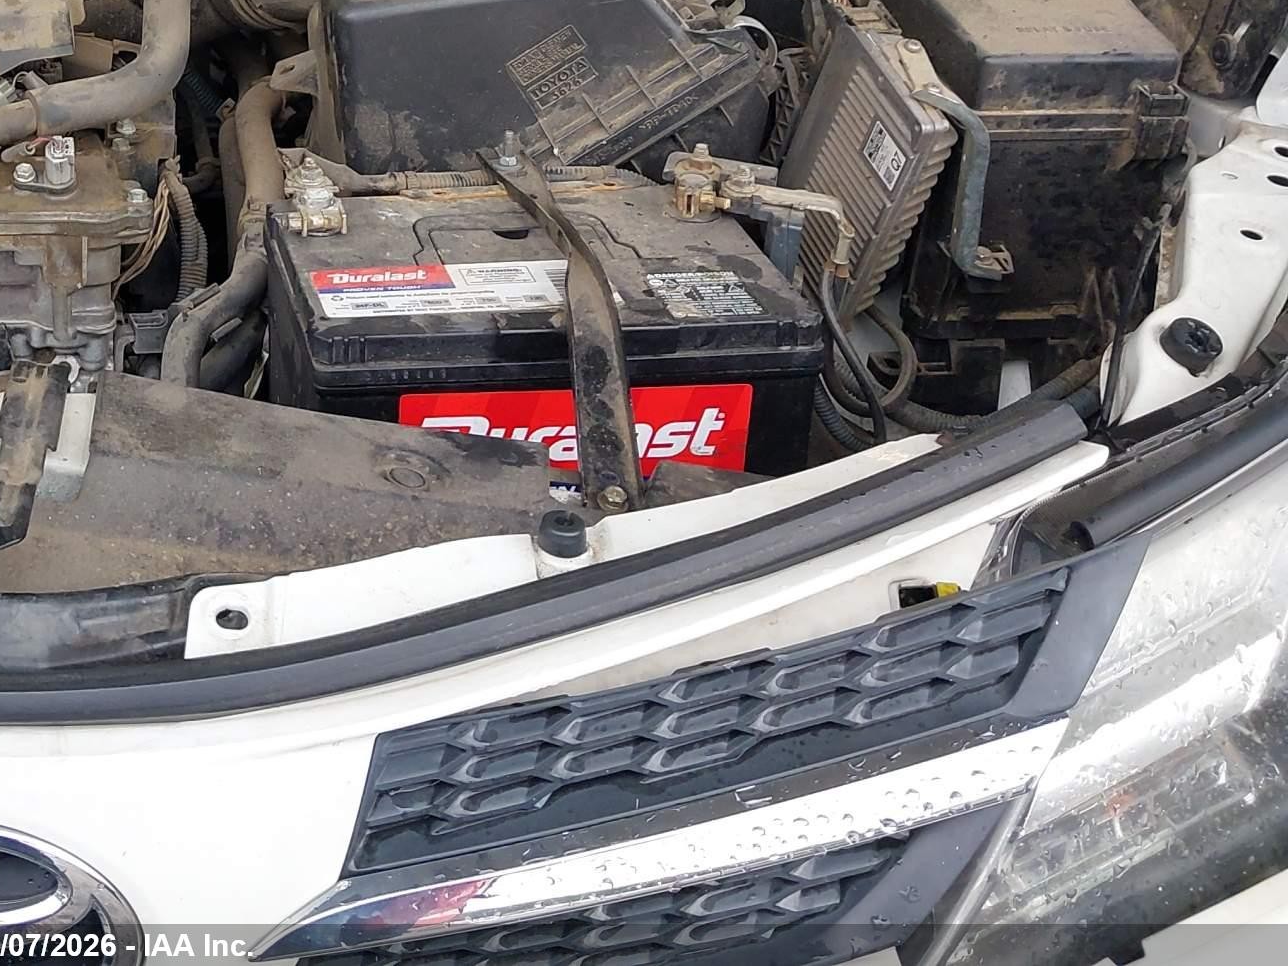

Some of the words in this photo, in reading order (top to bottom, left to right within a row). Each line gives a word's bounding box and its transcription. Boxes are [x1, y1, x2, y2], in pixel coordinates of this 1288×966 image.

[531, 59, 588, 99] TOYOTA
[890, 150, 903, 172] Q7
[327, 269, 428, 284] Duralast
